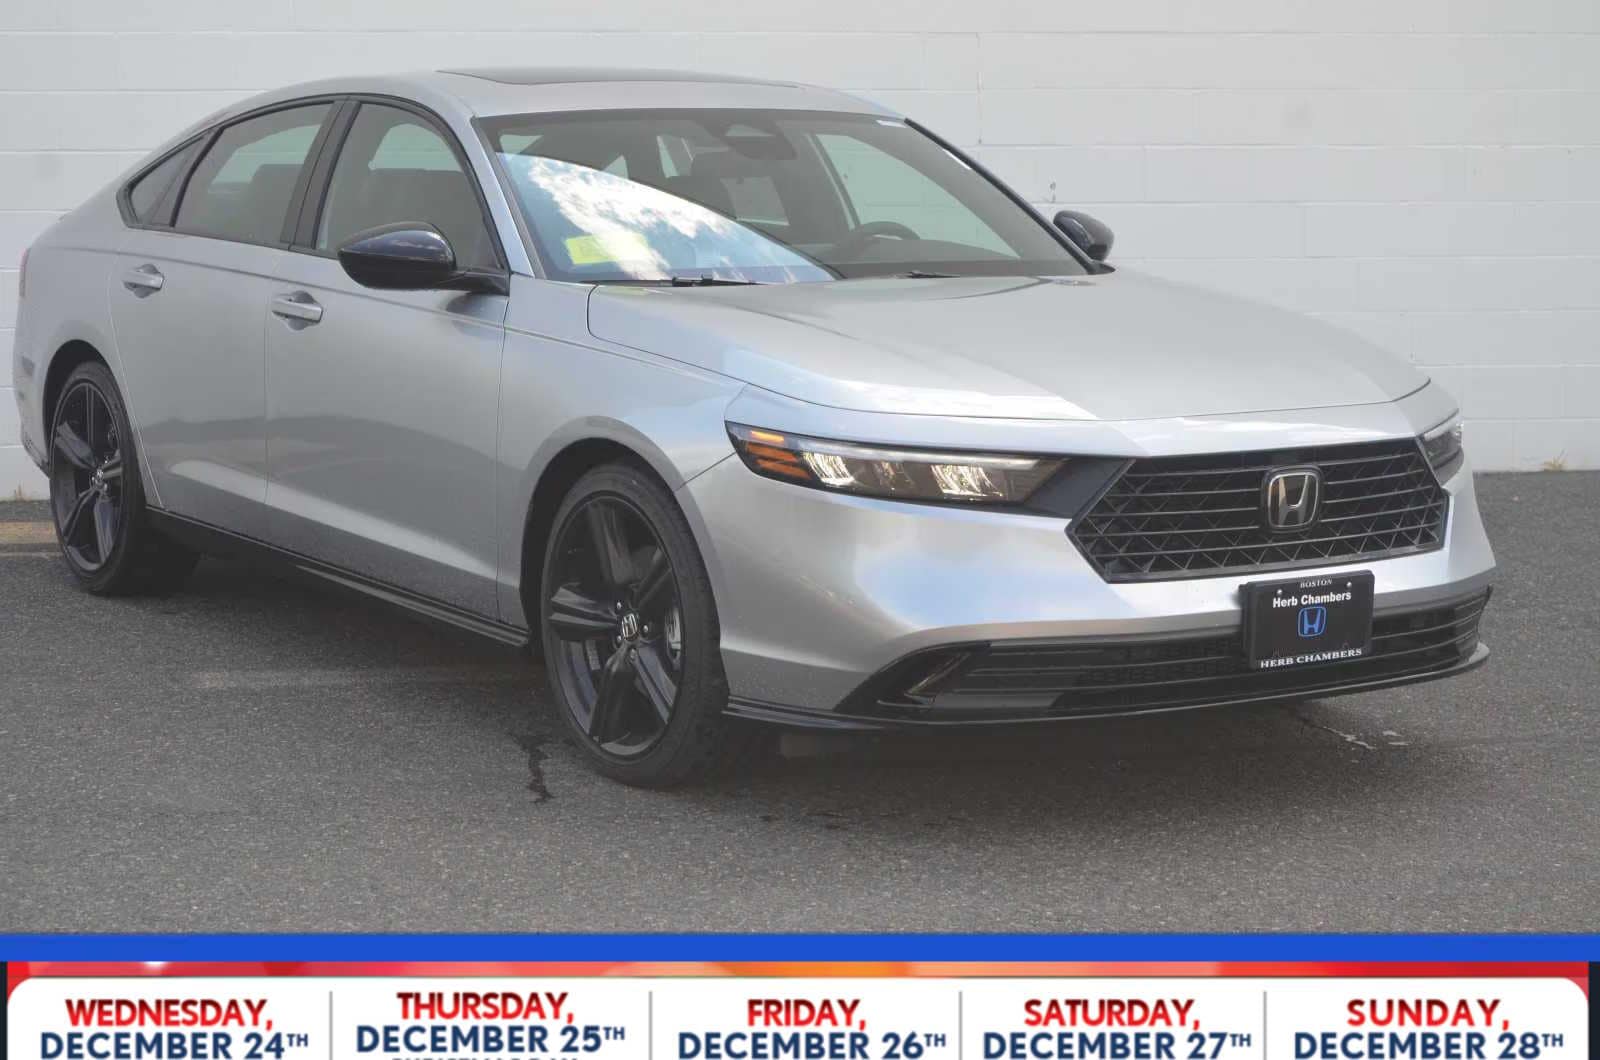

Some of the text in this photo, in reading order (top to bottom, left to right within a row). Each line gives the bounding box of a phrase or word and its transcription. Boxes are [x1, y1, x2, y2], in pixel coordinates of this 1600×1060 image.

[1300, 579, 1333, 589] BOSTON
[1272, 591, 1352, 609] Herb Chambers
[1260, 648, 1363, 669] HERB CHAMBERS
